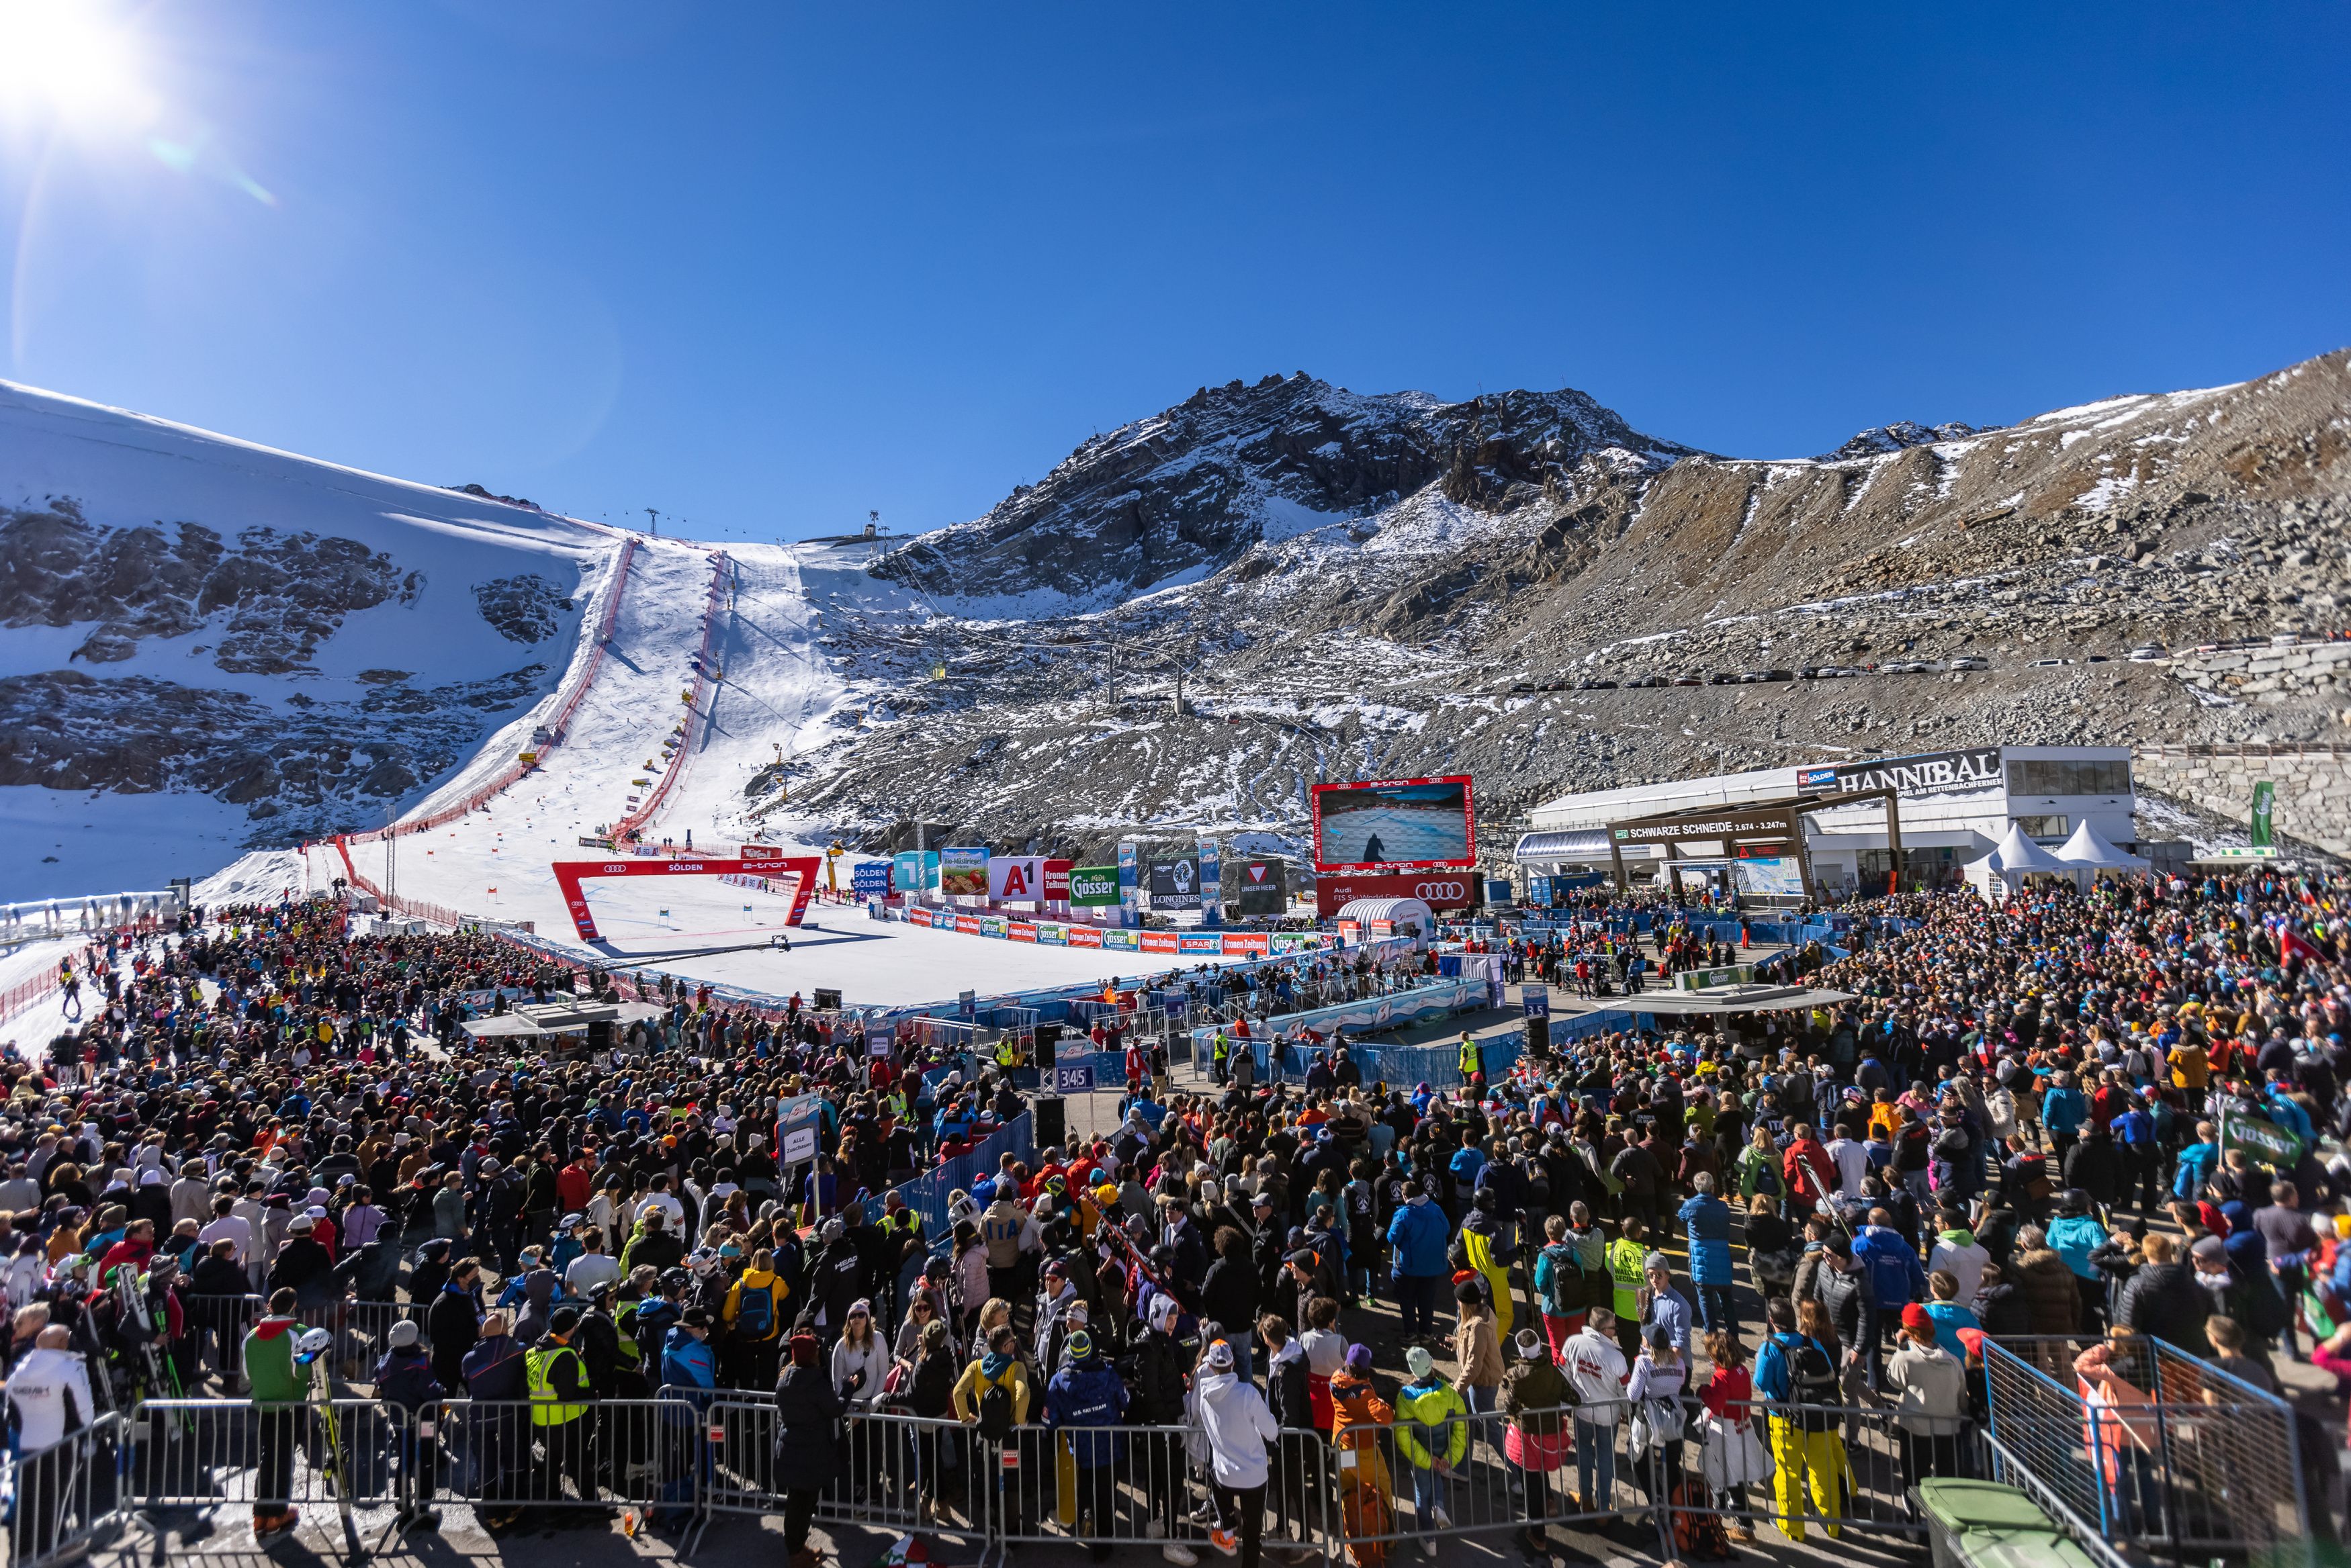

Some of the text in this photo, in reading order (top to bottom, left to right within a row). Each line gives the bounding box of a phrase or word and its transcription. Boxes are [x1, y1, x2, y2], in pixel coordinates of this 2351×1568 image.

[1809, 771, 1834, 782] SÖLDEN
[1837, 754, 2001, 792] HANNIBAL
[1928, 778, 2004, 794] RETTENBACHFERNER
[1630, 826, 1681, 838] SCHWARZE
[1682, 822, 1733, 835] SCHNEIDE
[1735, 823, 1754, 831] 2.674
[1760, 821, 1787, 829] 3.247m
[1798, 817, 1807, 847] SCHNEIDE
[855, 868, 885, 877] SÖLDEN
[1003, 861, 1034, 896] A1
[1045, 871, 1069, 880] Kronen
[854, 880, 886, 888] SÖLDEN
[1046, 880, 1069, 889] Zeitung
[1071, 875, 1115, 898] Gösser
[1154, 894, 1200, 903] LONGINES
[981, 919, 999, 933] Gösser
[1009, 927, 1035, 938] Kronen Zeitung
[1038, 926, 1058, 940] Gösser
[1070, 933, 1100, 943] Kronen Zeitung
[1104, 931, 1127, 946] Gösser
[1142, 938, 1176, 948] Kronen Zeitung
[1225, 939, 1266, 950] Kronen Zeitung
[1710, 971, 1729, 986] Gösser
[793, 1136, 805, 1144] ALLE
[2228, 1120, 2297, 1154] Gösser
[787, 1142, 812, 1154] Zuschauer
[835, 1255, 858, 1270] HEAD
[1615, 1275, 1644, 1284] SECURITY
[130, 1274, 145, 1312] HEAD
[1092, 1403, 1106, 1412] TEAM
